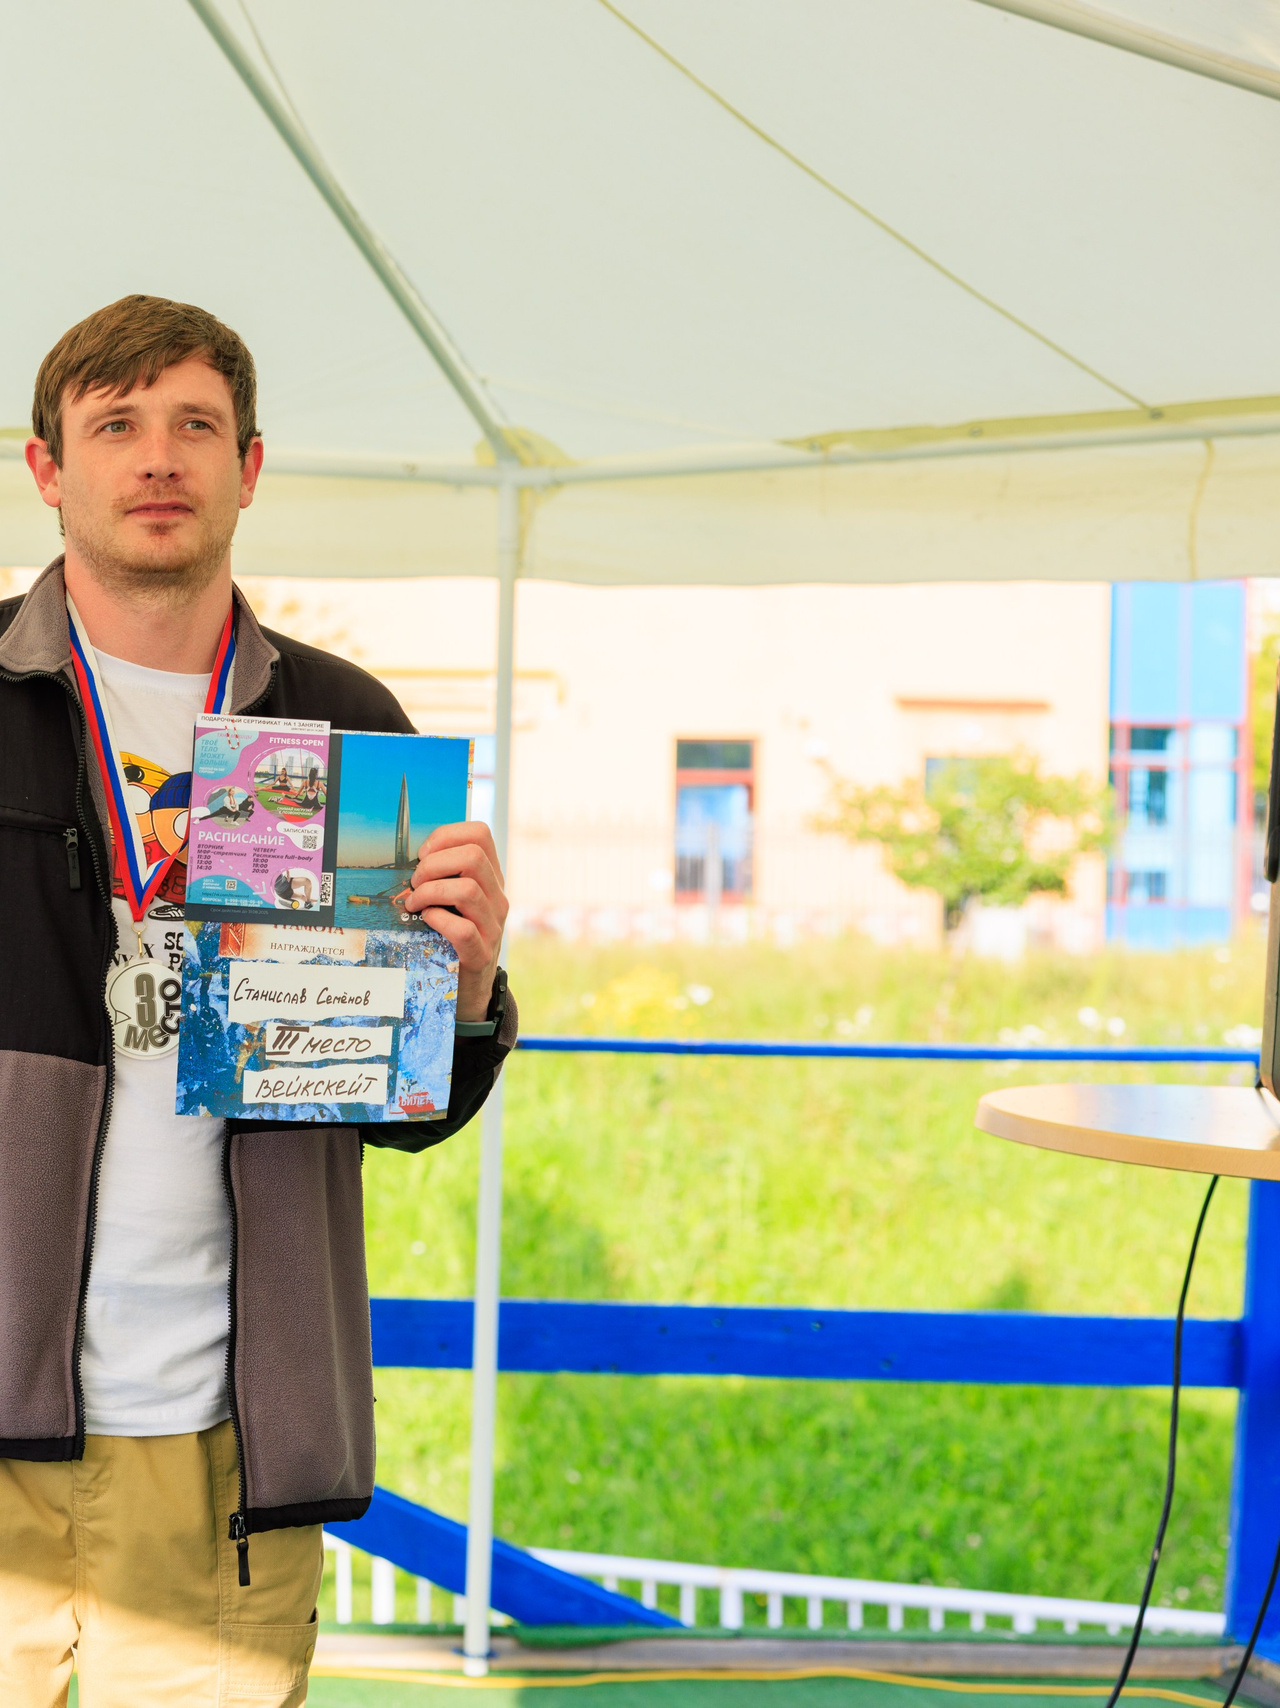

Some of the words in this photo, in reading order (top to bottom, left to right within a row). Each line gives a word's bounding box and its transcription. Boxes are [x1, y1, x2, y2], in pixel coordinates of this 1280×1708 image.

[243, 718, 281, 726] СЕРТИФИКАТ
[269, 736, 301, 745] FITNESS
[302, 739, 324, 747] OPEN
[200, 752, 226, 760] МОЖЕТ
[199, 759, 229, 767] БОЛЬШЕ
[198, 830, 285, 846] РАСПИСАНИЕ
[284, 854, 314, 862] full-body
[270, 942, 345, 956] НАГРАЖДАЕТСЯ
[134, 973, 157, 1029] 3
